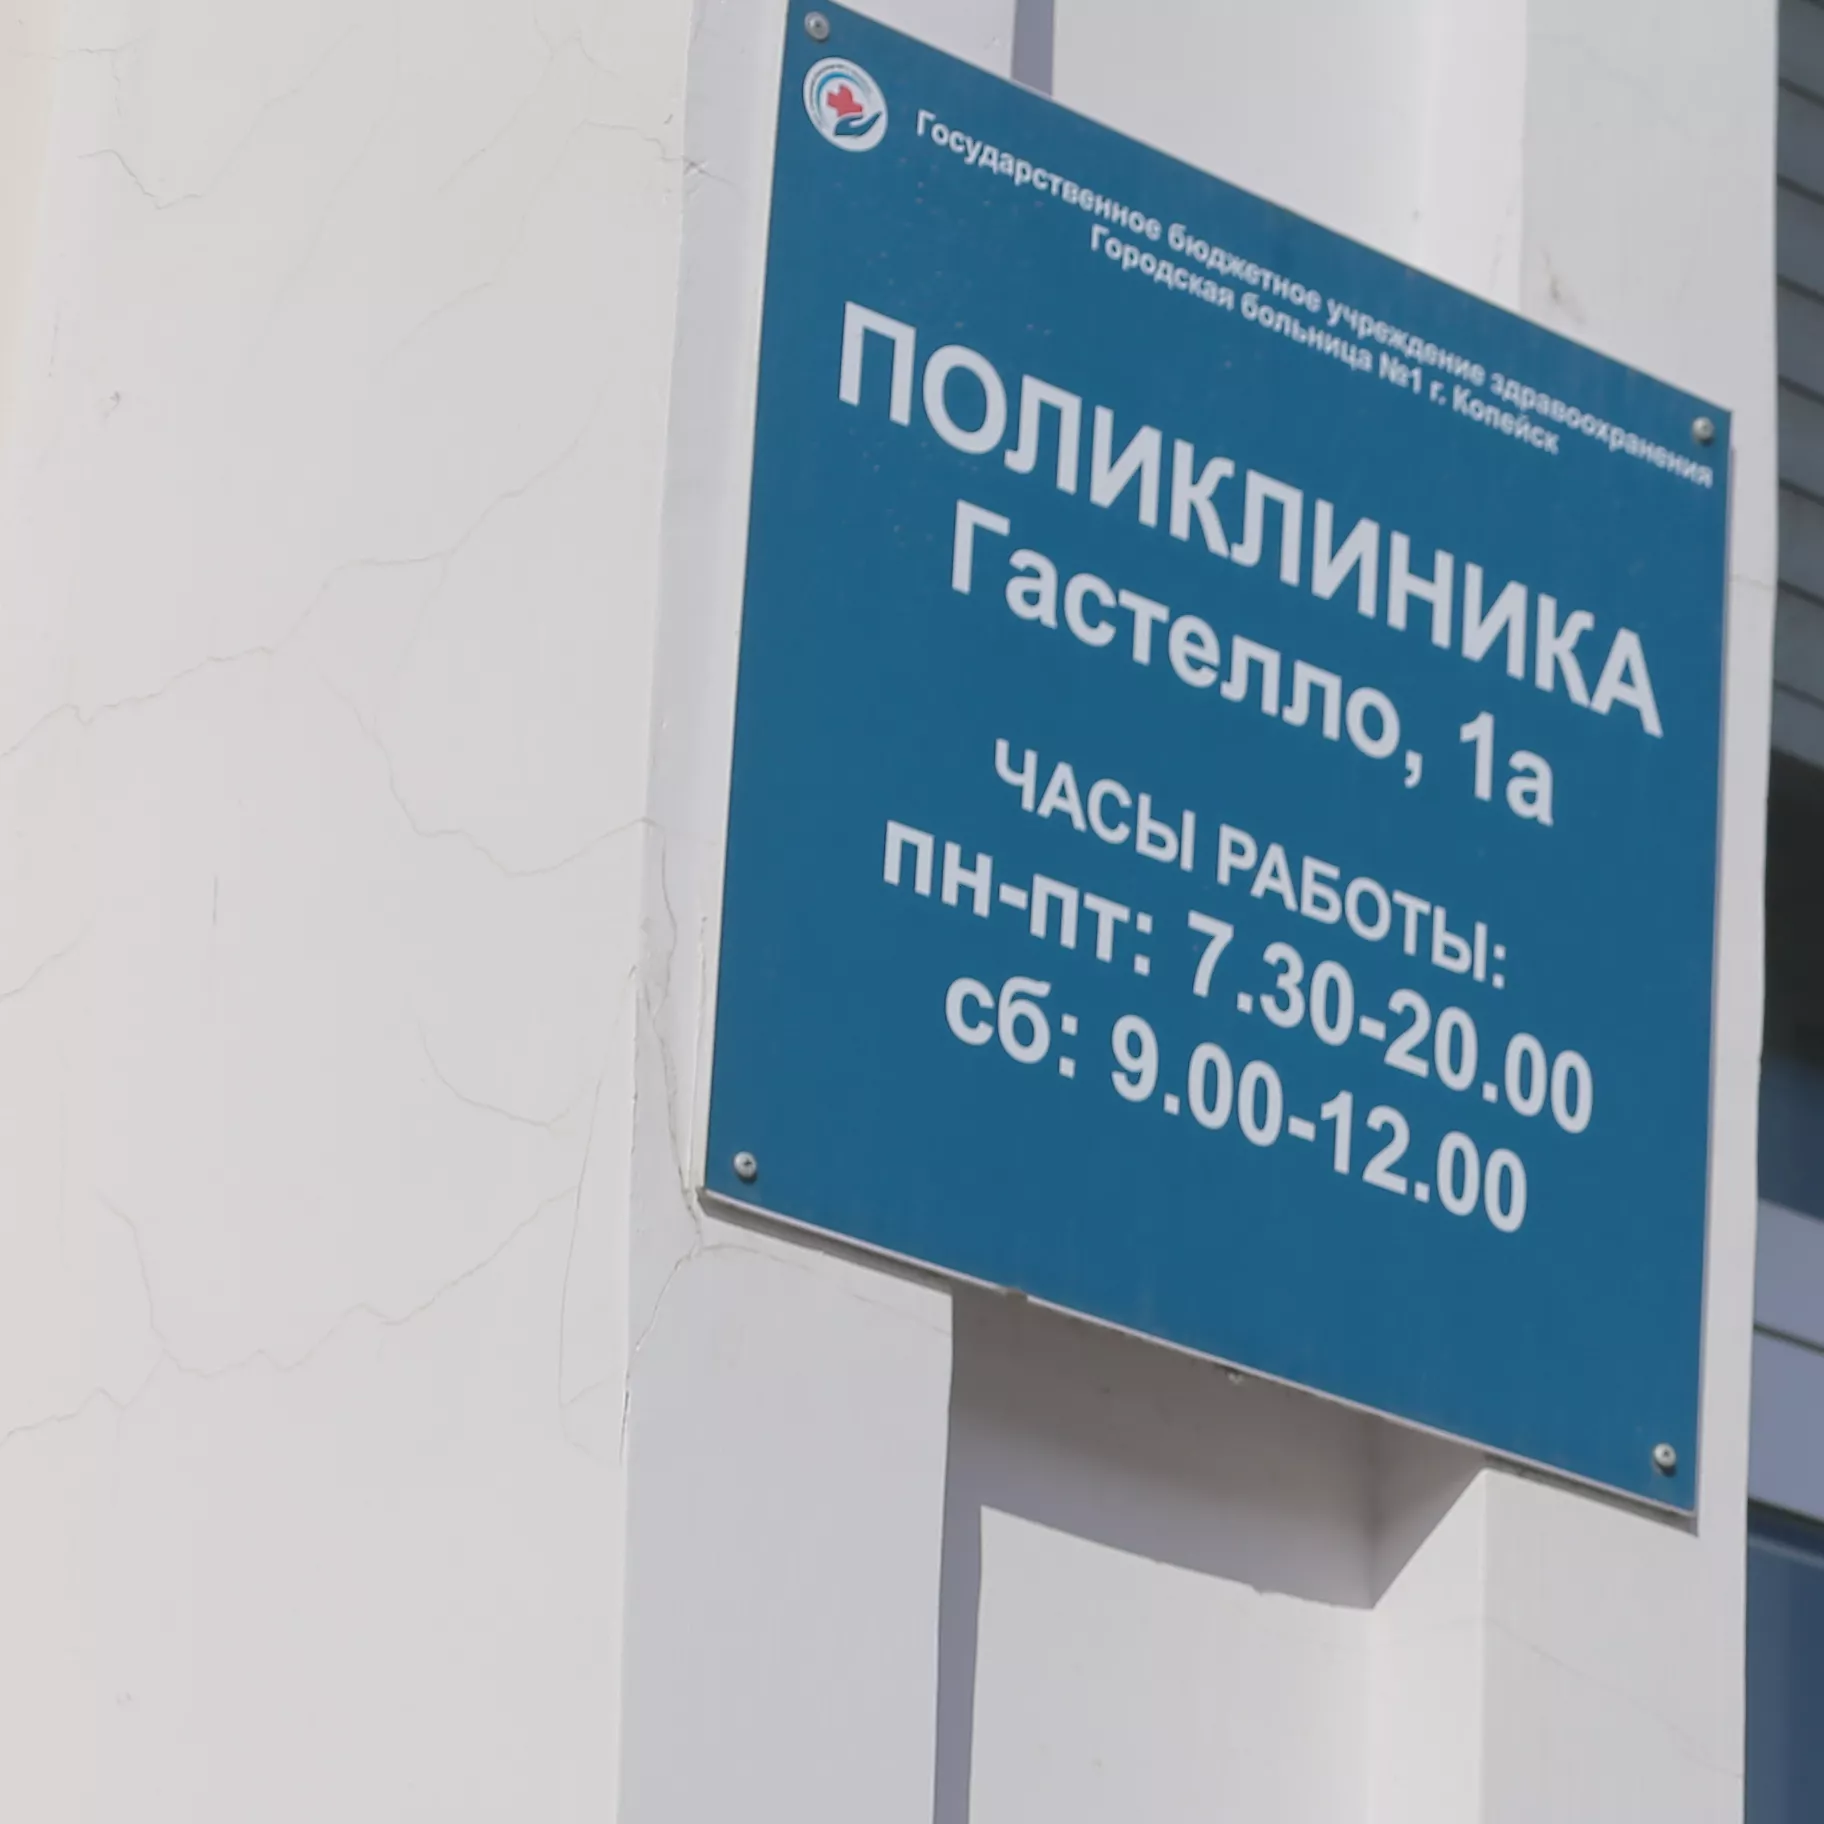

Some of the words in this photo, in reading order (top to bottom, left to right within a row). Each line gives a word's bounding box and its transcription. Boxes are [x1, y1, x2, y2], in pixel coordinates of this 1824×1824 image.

[915, 109, 1162, 241] Государственное
[1167, 222, 1322, 313] бюджетное
[1327, 298, 1486, 386] учреждение
[1490, 372, 1713, 488] здравоохранения
[1090, 223, 1235, 311] Городская
[1240, 291, 1373, 372] больница
[1378, 350, 1423, 393] №1
[1429, 380, 1448, 405] г.
[1452, 384, 1559, 454] Копейск
[839, 301, 1663, 737] ПОЛИКЛИНИКА
[952, 500, 1422, 788] Гастелло,
[1460, 712, 1553, 826] 1а
[995, 738, 1195, 871] ЧАСЫ
[1217, 824, 1506, 989] РАБОТЫ:
[945, 976, 1078, 1078] сб:
[1111, 1015, 1527, 1232] 9.00-12.00
[1188, 910, 1593, 1133] 7.30-20.00
